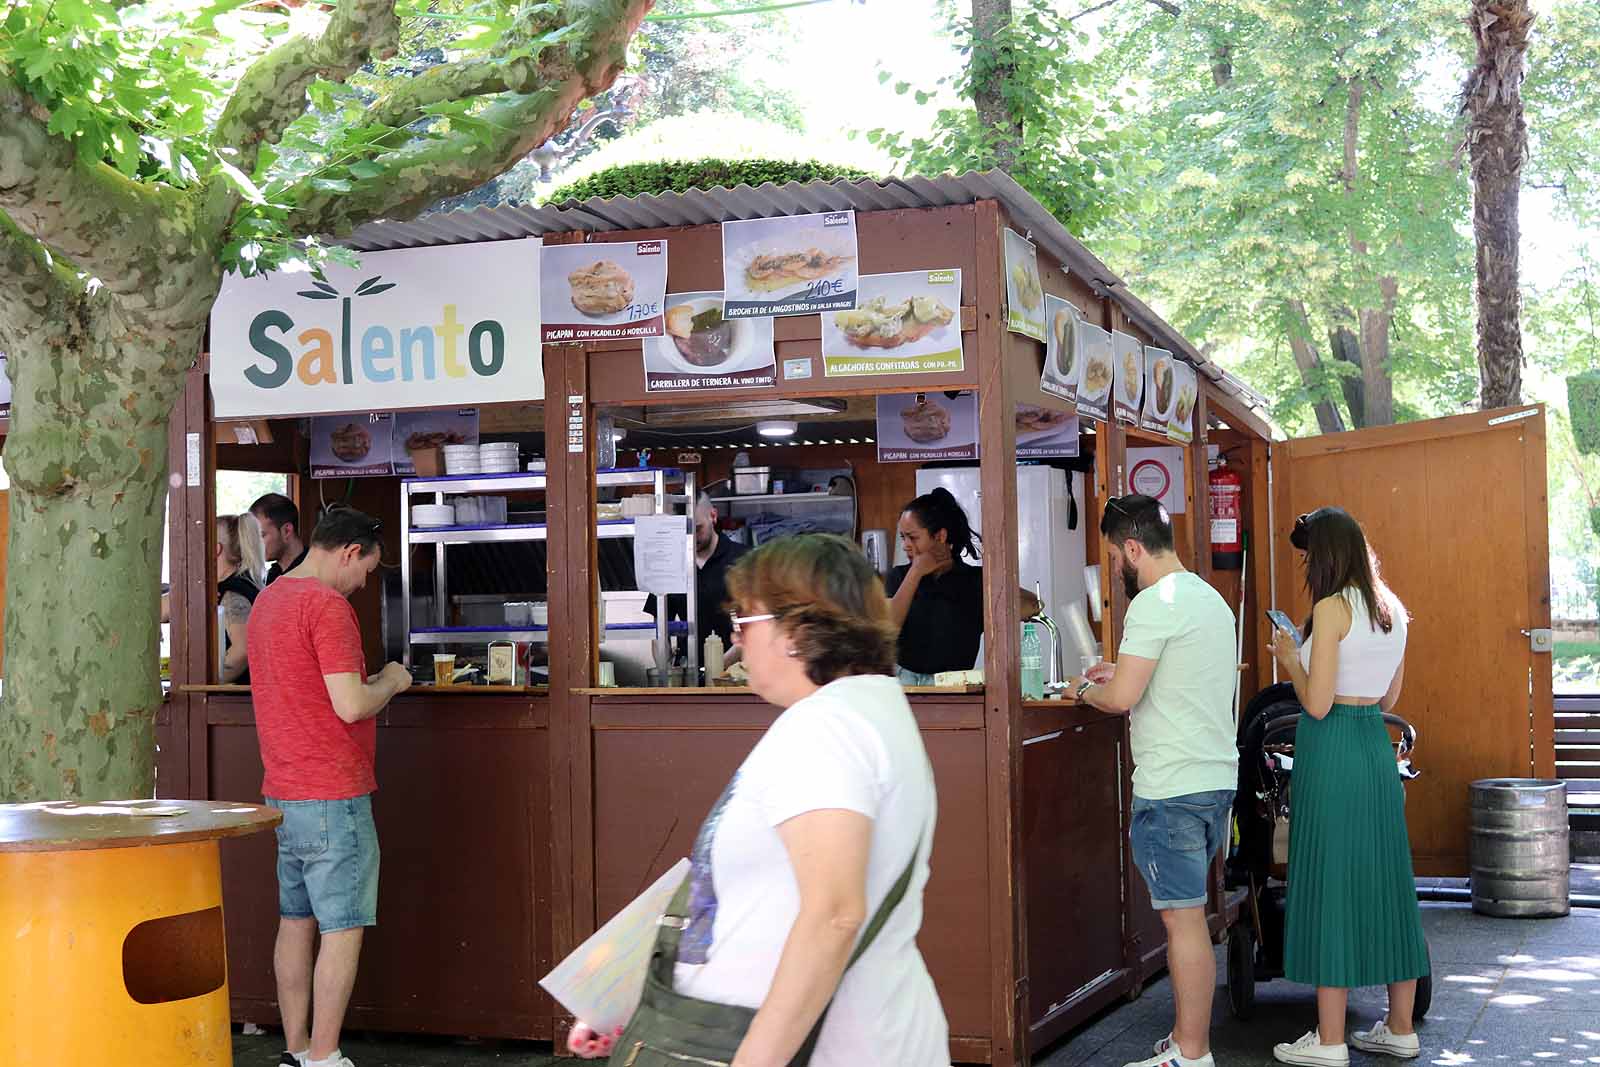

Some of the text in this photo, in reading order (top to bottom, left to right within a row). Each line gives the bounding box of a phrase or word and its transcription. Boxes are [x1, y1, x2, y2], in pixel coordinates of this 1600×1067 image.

[638, 244, 661, 253] Salento
[728, 307, 759, 316] BROCHETA
[760, 306, 768, 314] DE
[768, 303, 810, 313] LANGOSTINOS
[546, 328, 574, 339] PICAPAN
[577, 330, 589, 338] CON
[590, 329, 620, 337] PICADILLO
[627, 326, 657, 335] MORCILLA
[243, 296, 505, 389] Salento
[830, 361, 874, 372] ALCACHOFAS
[875, 360, 920, 371] CONFITADAS
[650, 378, 690, 389] CARRILLERA
[691, 378, 700, 387] DE
[702, 376, 732, 386] TERNERA
